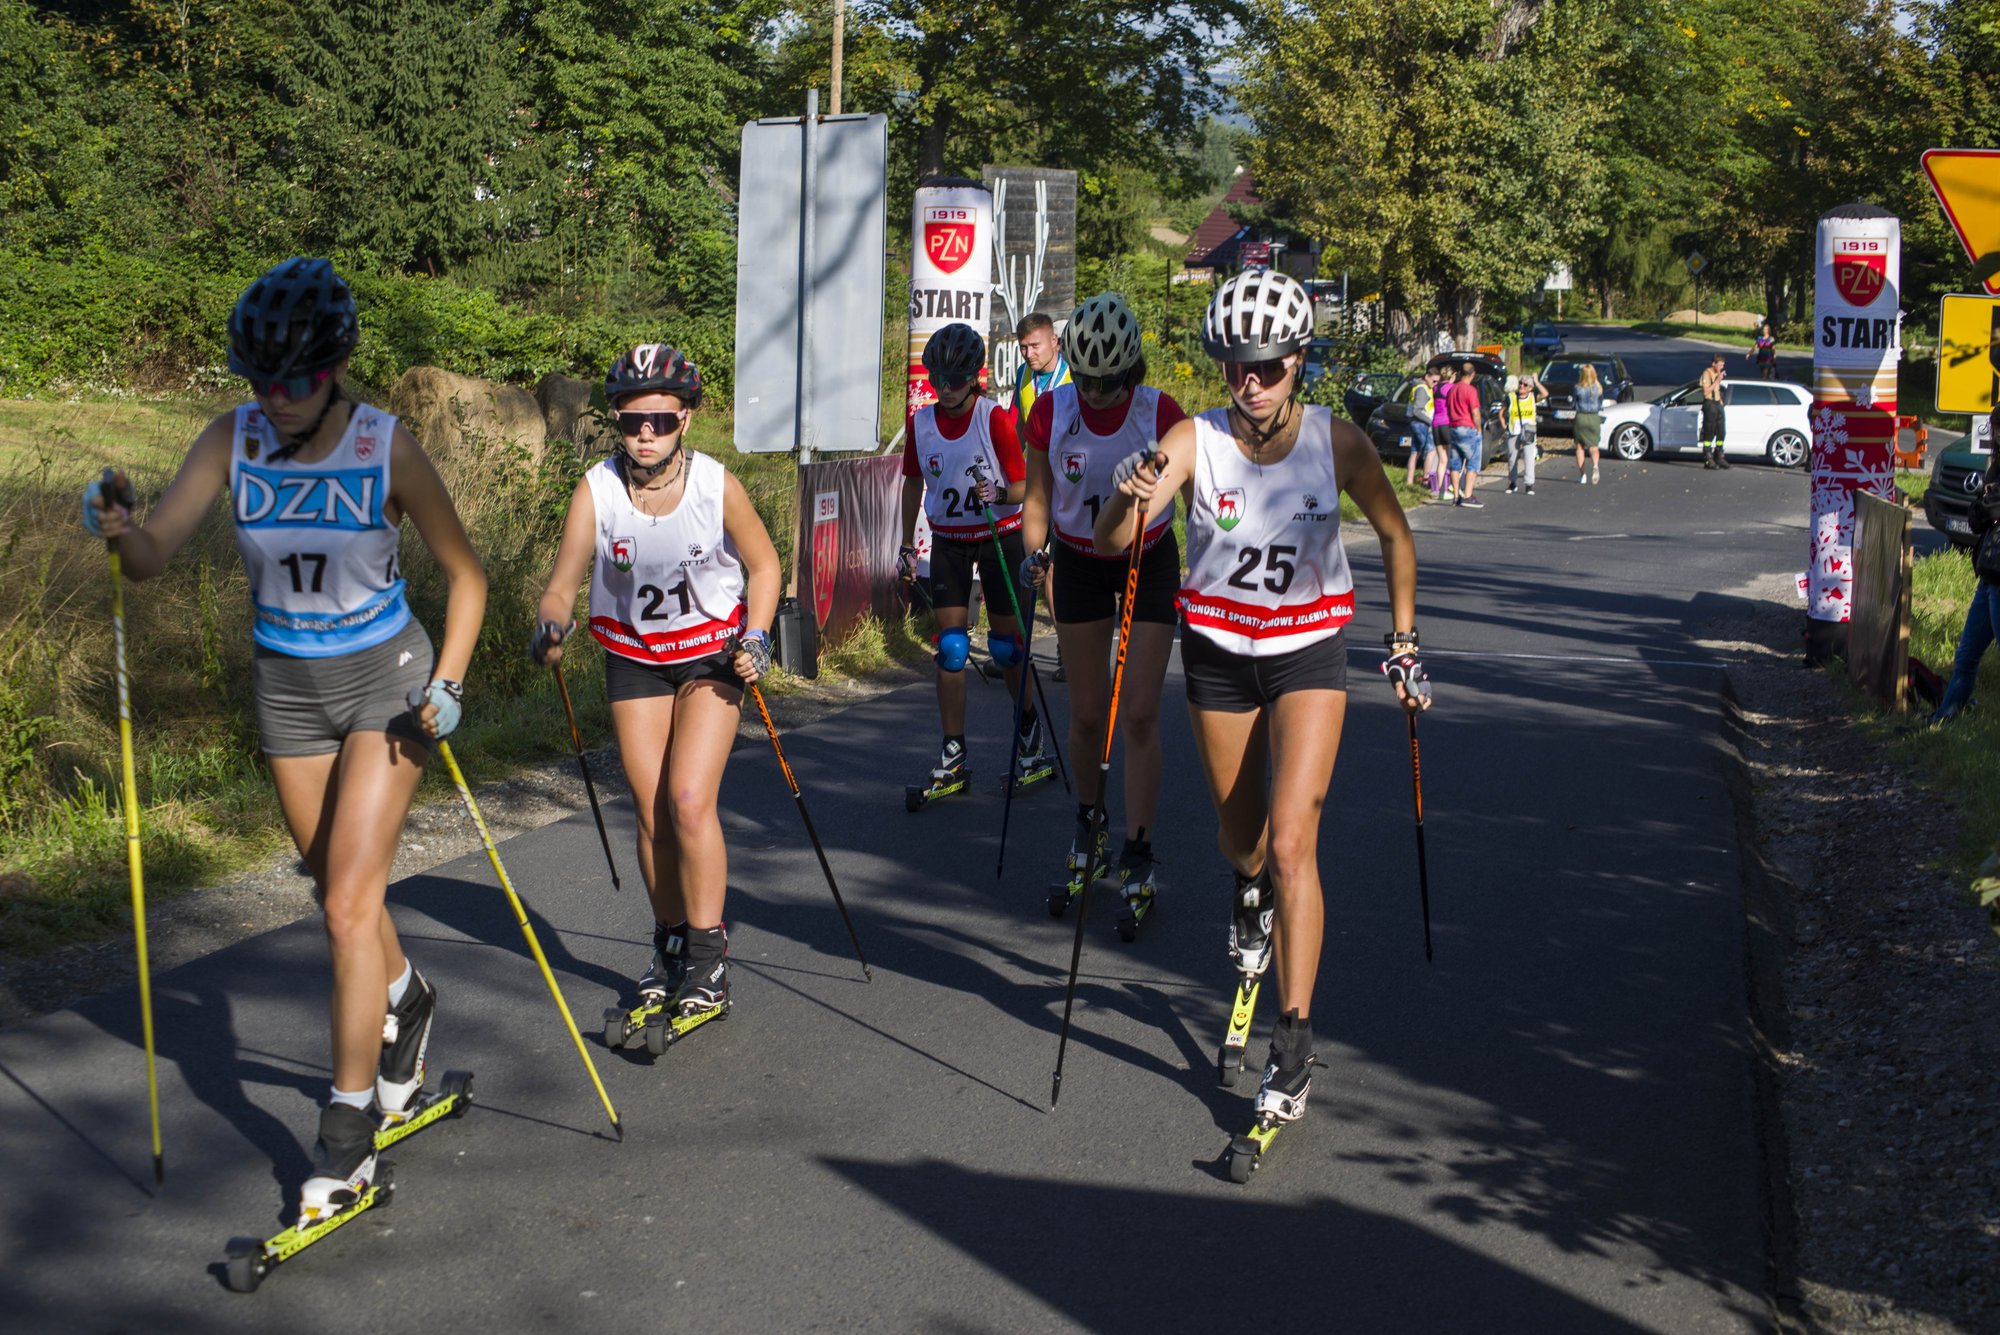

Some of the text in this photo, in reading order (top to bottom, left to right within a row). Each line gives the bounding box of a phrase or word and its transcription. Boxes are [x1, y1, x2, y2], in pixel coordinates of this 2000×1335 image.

[932, 210, 967, 220] 1919
[931, 228, 968, 262] PZN
[1842, 241, 1879, 251] 1919
[1841, 260, 1881, 295] PZN
[912, 288, 984, 320] START
[994, 340, 1020, 388] CHO
[237, 469, 377, 528] DZN
[942, 487, 983, 518] 24
[279, 552, 327, 594] 17
[1227, 544, 1298, 596] 25
[637, 580, 690, 622] 21
[1228, 611, 1260, 628] SPORTY
[1295, 609, 1330, 626] JELENIA
[1330, 604, 1353, 617] GÓRA
[650, 641, 676, 653] PORTY
[678, 634, 713, 650] ZIMOWE
